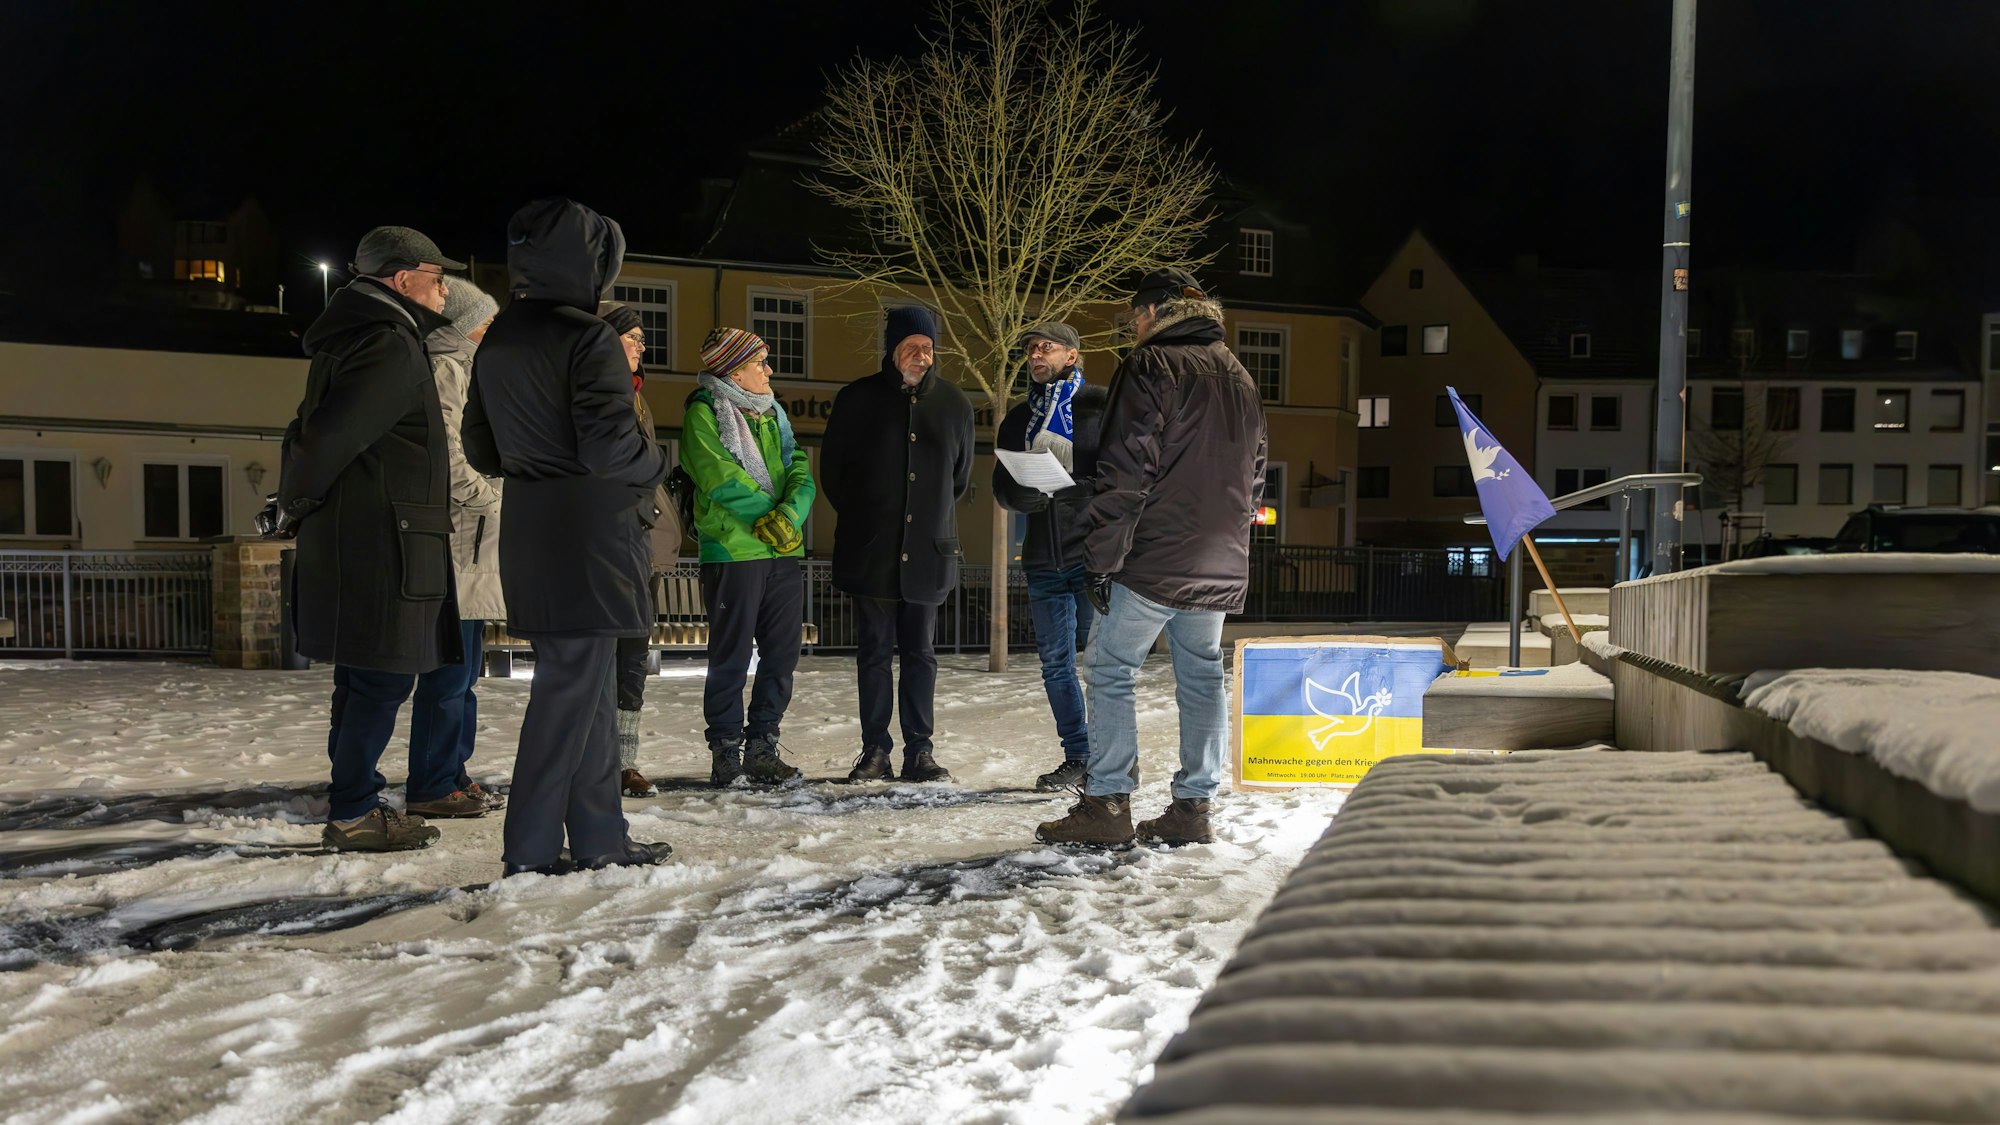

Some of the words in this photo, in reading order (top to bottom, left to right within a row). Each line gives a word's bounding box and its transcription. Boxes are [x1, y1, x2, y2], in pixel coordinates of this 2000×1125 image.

[774, 391, 832, 419] ote
[1248, 757, 1303, 765] Mahnwache
[1305, 758, 1333, 767] gegen
[1335, 757, 1352, 766] den
